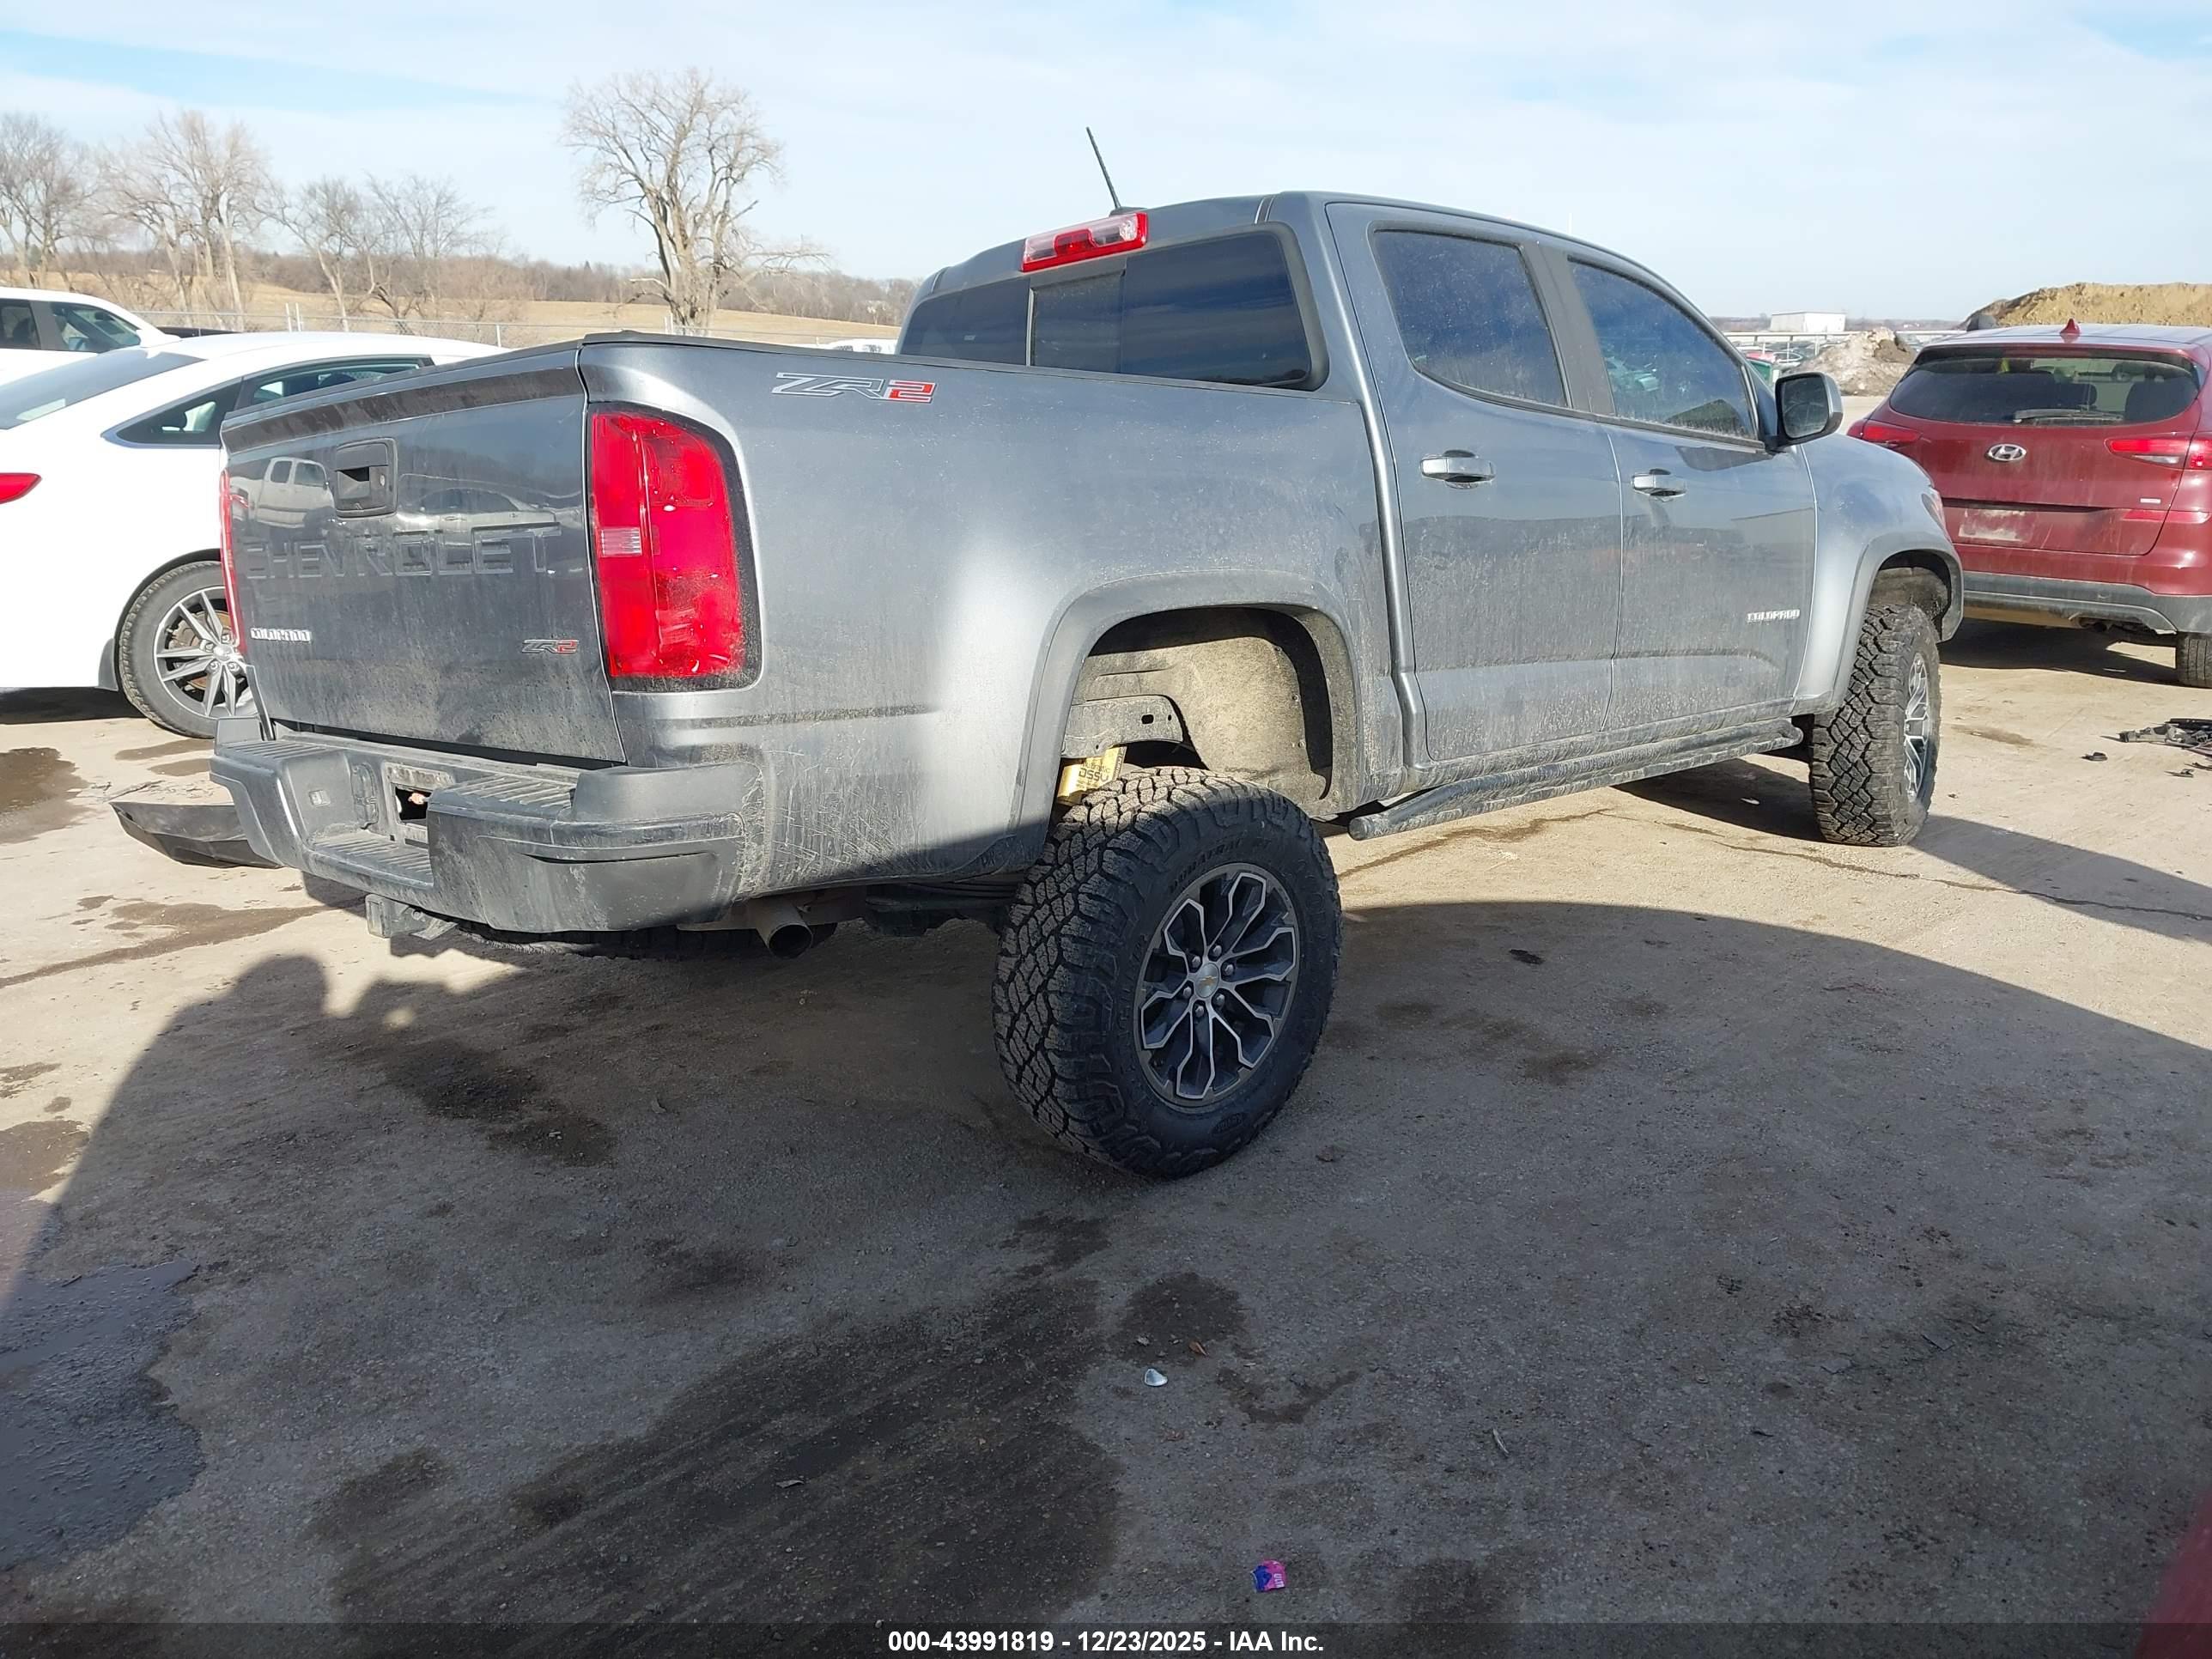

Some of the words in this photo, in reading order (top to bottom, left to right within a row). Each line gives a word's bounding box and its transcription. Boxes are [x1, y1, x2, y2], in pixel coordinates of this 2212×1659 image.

[771, 372, 936, 403] ZR2
[244, 522, 562, 580] CHEVROLET
[1747, 609, 1801, 623] COLORADO
[521, 639, 580, 653] ZR2
